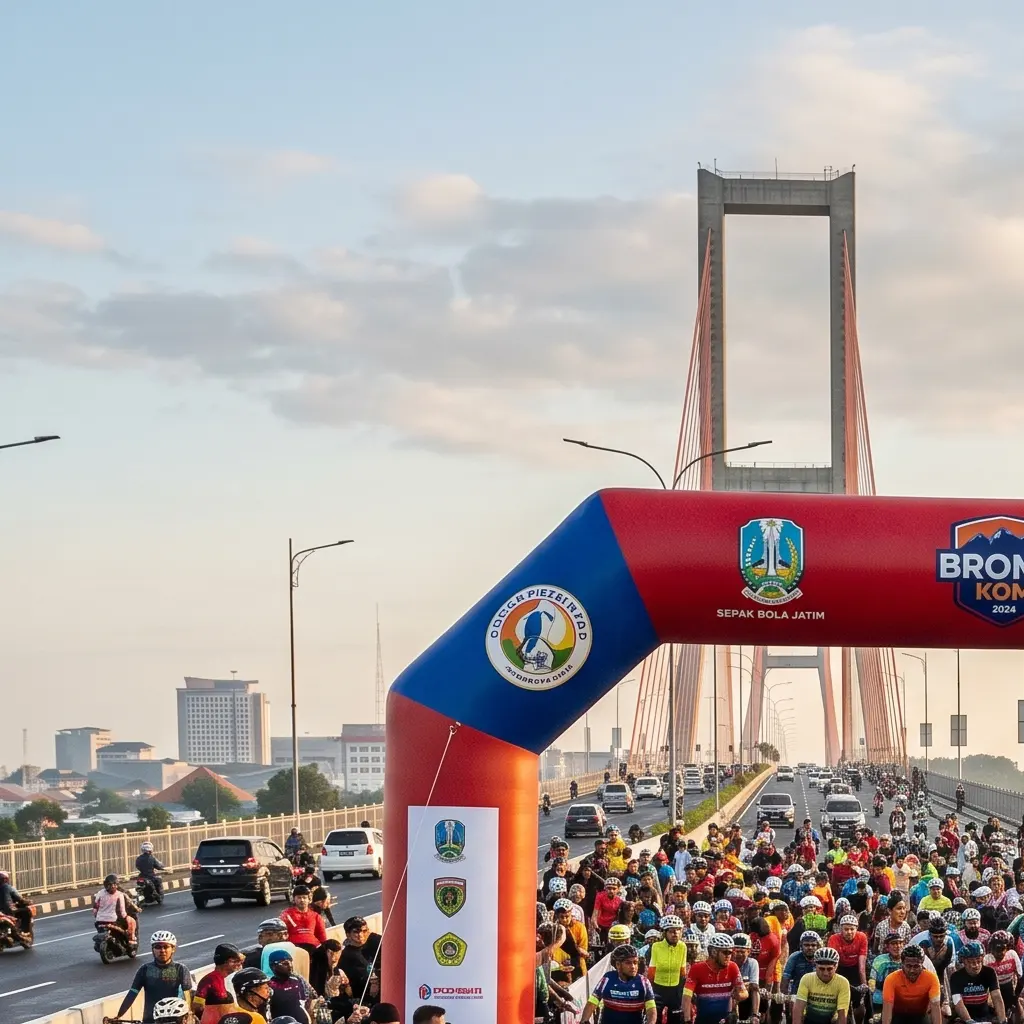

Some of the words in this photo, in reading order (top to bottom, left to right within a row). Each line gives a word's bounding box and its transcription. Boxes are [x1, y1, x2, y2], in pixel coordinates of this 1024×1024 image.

[716, 608, 755, 620] SEPAK
[757, 610, 790, 620] BOLA
[791, 610, 825, 621] JATIM
[991, 604, 1017, 614] 2024
